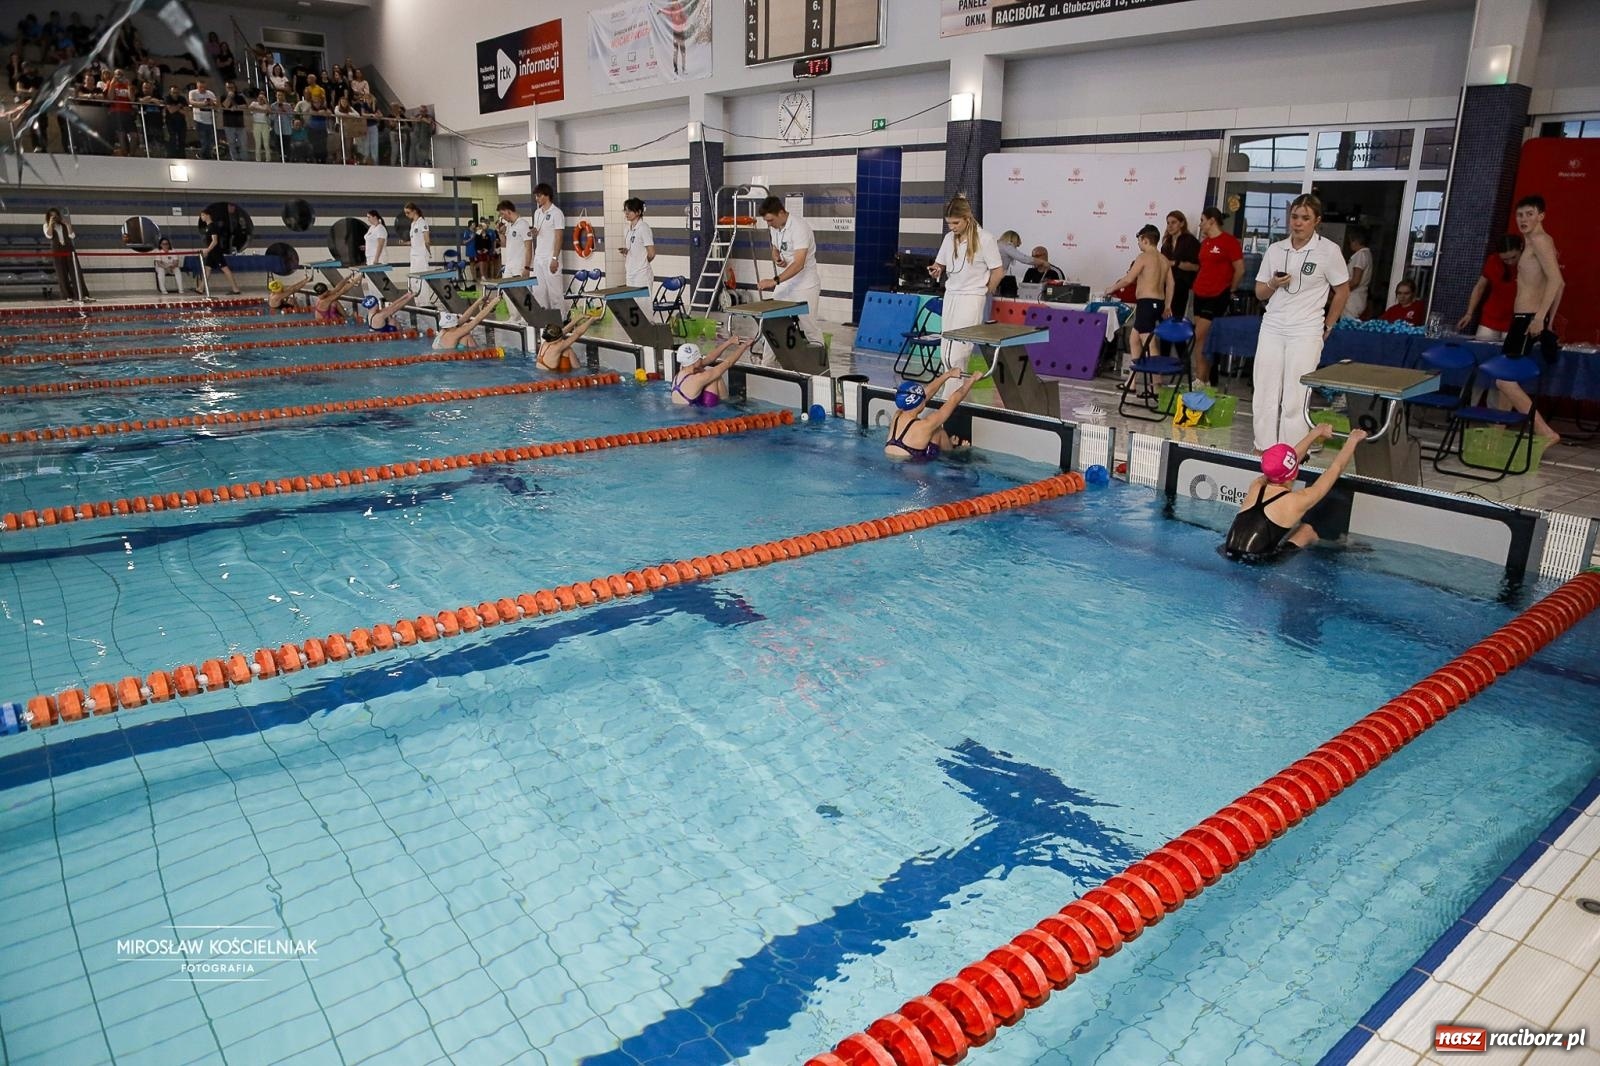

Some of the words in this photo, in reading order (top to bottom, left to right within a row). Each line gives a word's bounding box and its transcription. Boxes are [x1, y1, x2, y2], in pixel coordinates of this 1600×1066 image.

[812, 0, 821, 11] 6.
[748, 14, 756, 25] 2.
[965, 13, 987, 27] OKNA
[995, 3, 1046, 25] RACIBÓRZ
[1049, 4, 1060, 16] ul.
[812, 19, 820, 30] 7.
[748, 32, 756, 42] 3.
[811, 38, 819, 48] 8.
[748, 50, 756, 60] 4.
[519, 51, 560, 76] informacji
[499, 65, 512, 81] rtk
[383, 278, 390, 291] 2
[444, 285, 451, 300] 3
[523, 294, 533, 312] 4
[629, 306, 640, 327] 5
[786, 325, 796, 349] 6
[1018, 355, 1029, 386] 7
[1391, 408, 1403, 446] 8
